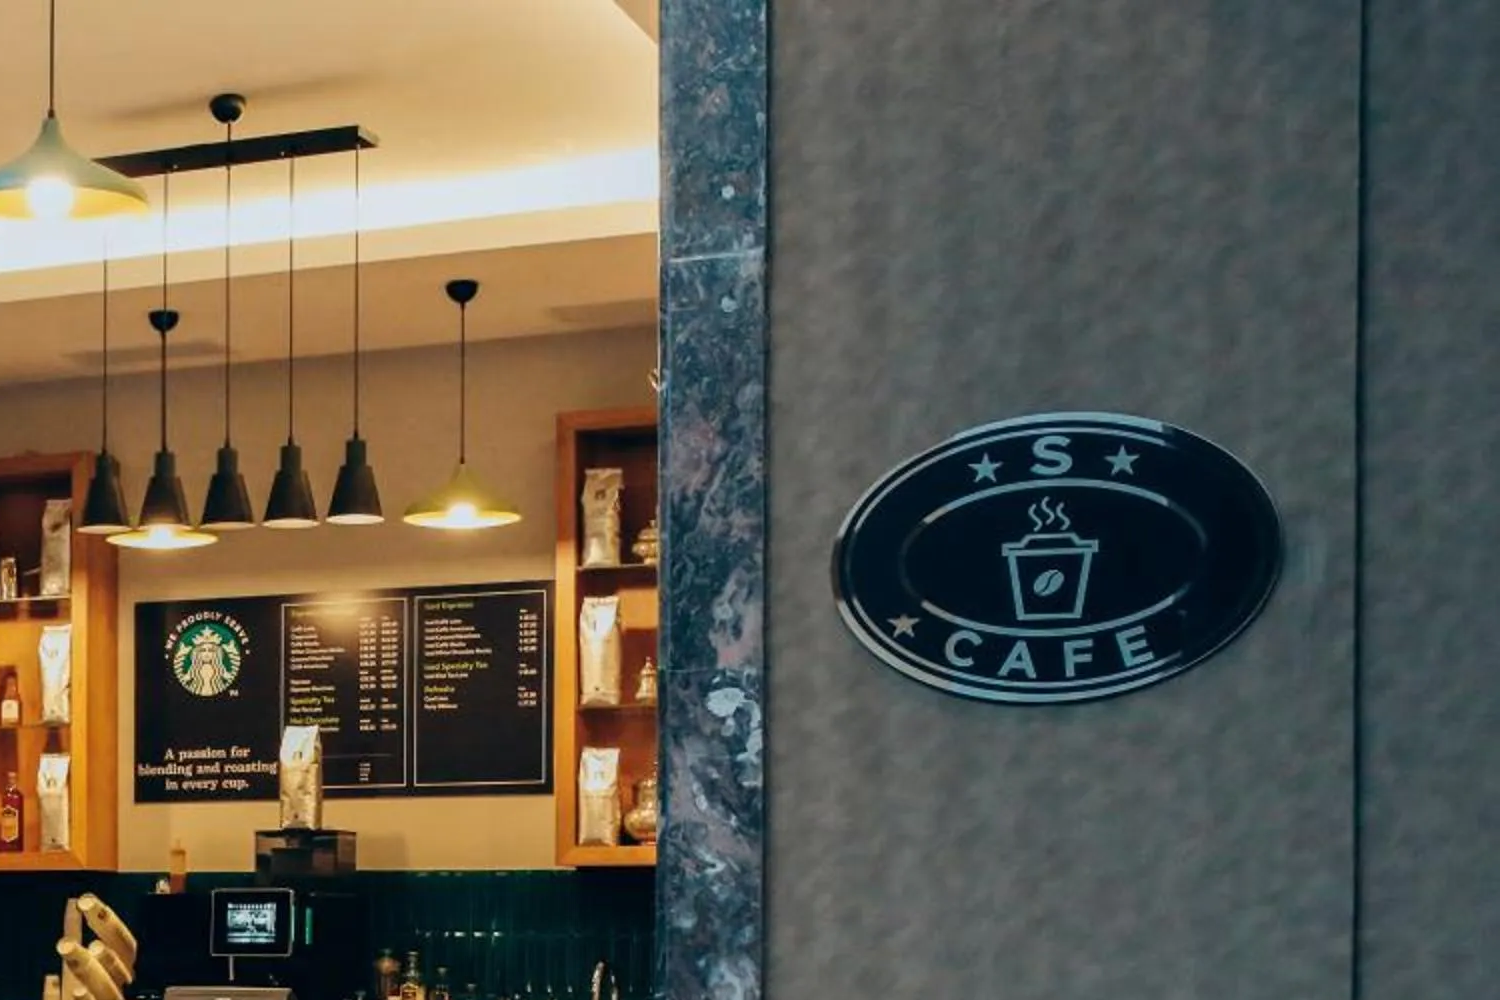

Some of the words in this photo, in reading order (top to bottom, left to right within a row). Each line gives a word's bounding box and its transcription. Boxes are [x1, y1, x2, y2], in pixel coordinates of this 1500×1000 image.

[1030, 435, 1073, 476] S
[176, 611, 223, 633] PROUDLY
[944, 624, 1155, 679] CAFE
[164, 747, 175, 760] A
[179, 746, 227, 762] passion
[231, 745, 251, 759] for
[138, 763, 193, 777] blending
[196, 762, 220, 775] and
[223, 760, 278, 775] roasting
[165, 778, 179, 791] in
[181, 780, 219, 792] every
[221, 779, 250, 791] cup.
